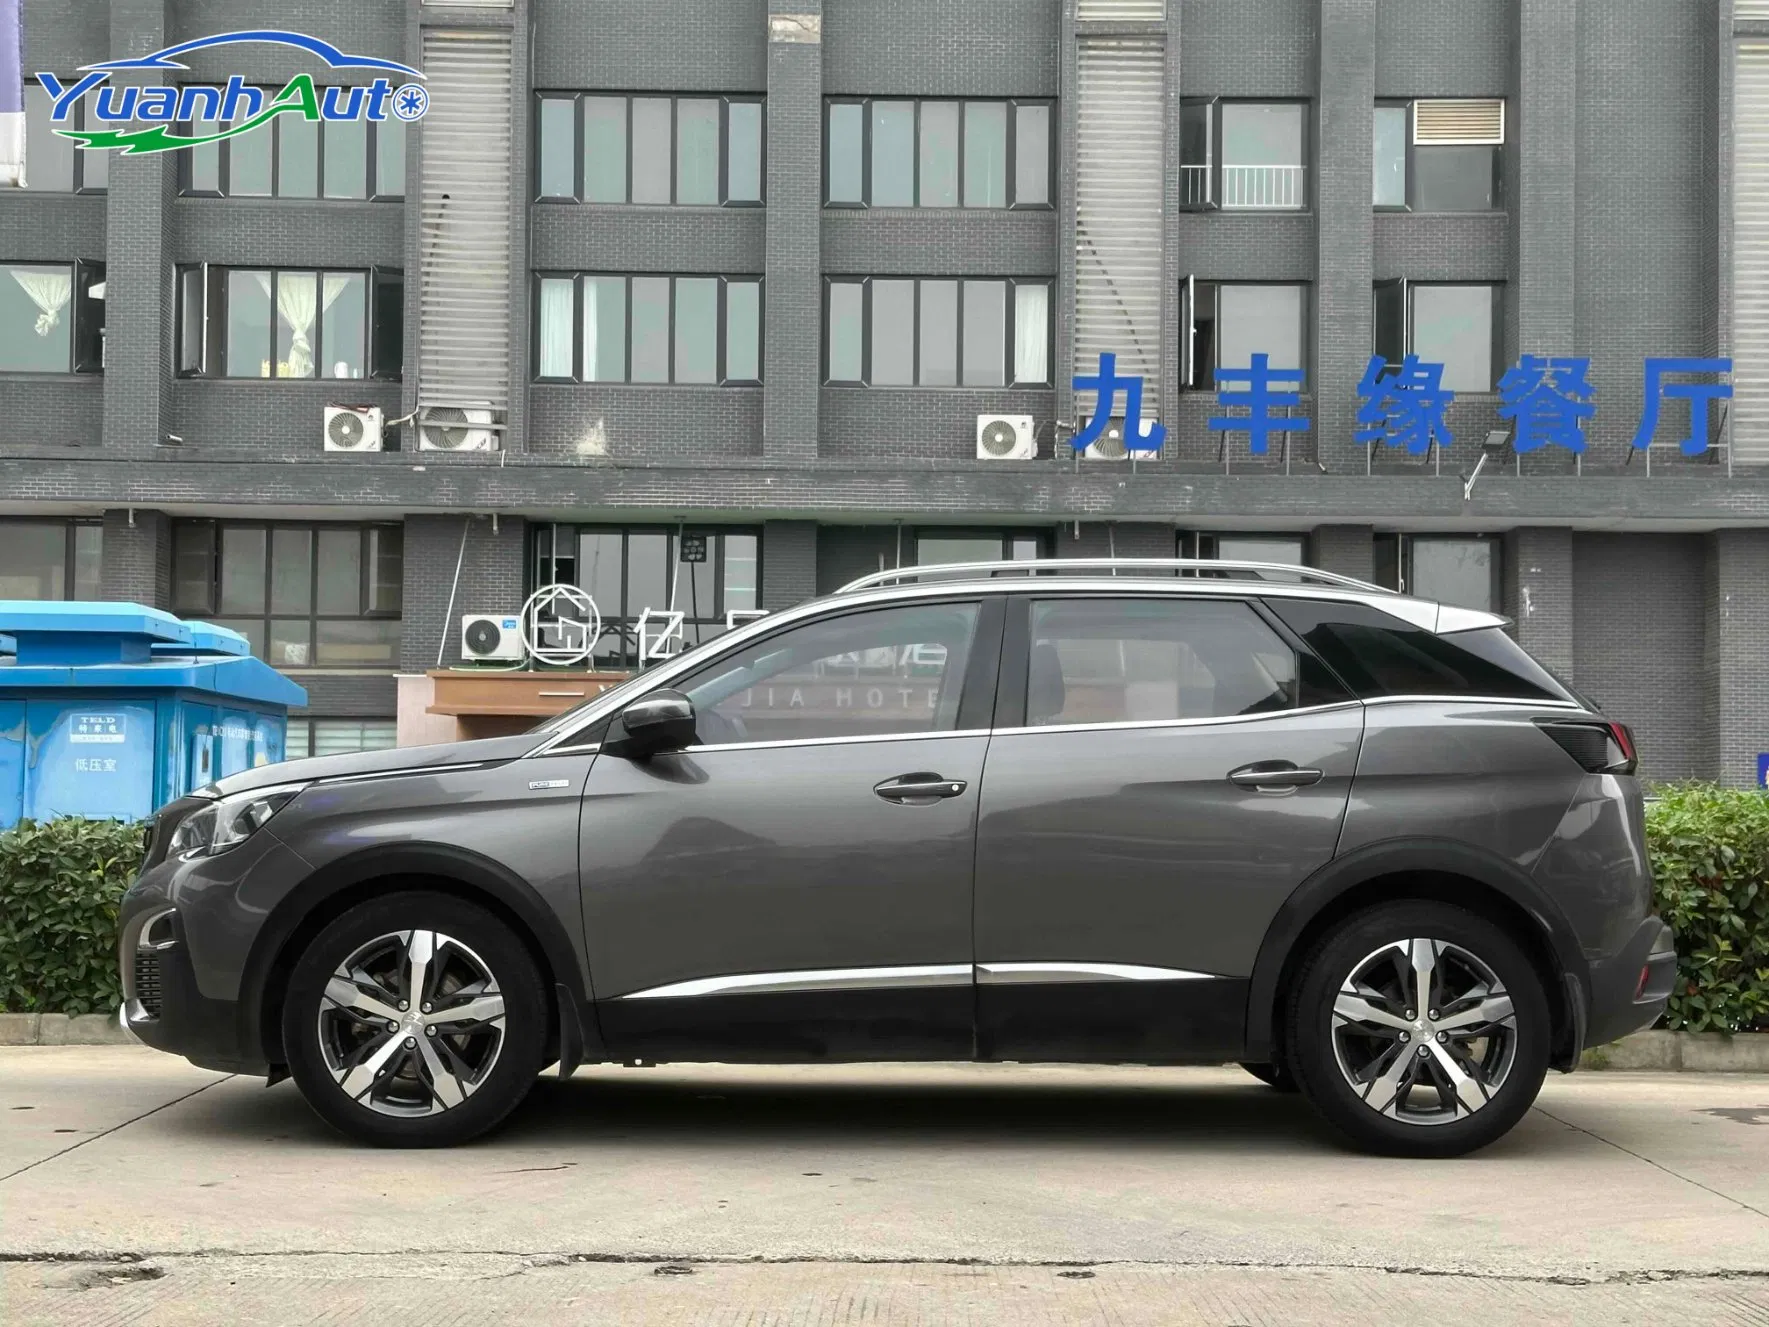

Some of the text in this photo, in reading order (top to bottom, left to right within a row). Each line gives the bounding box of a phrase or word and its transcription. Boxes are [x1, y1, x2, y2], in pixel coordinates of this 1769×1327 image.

[1070, 353, 1734, 456] 九丰缘餐厅
[741, 689, 806, 708] JIA
[75, 758, 117, 772] 低压室
